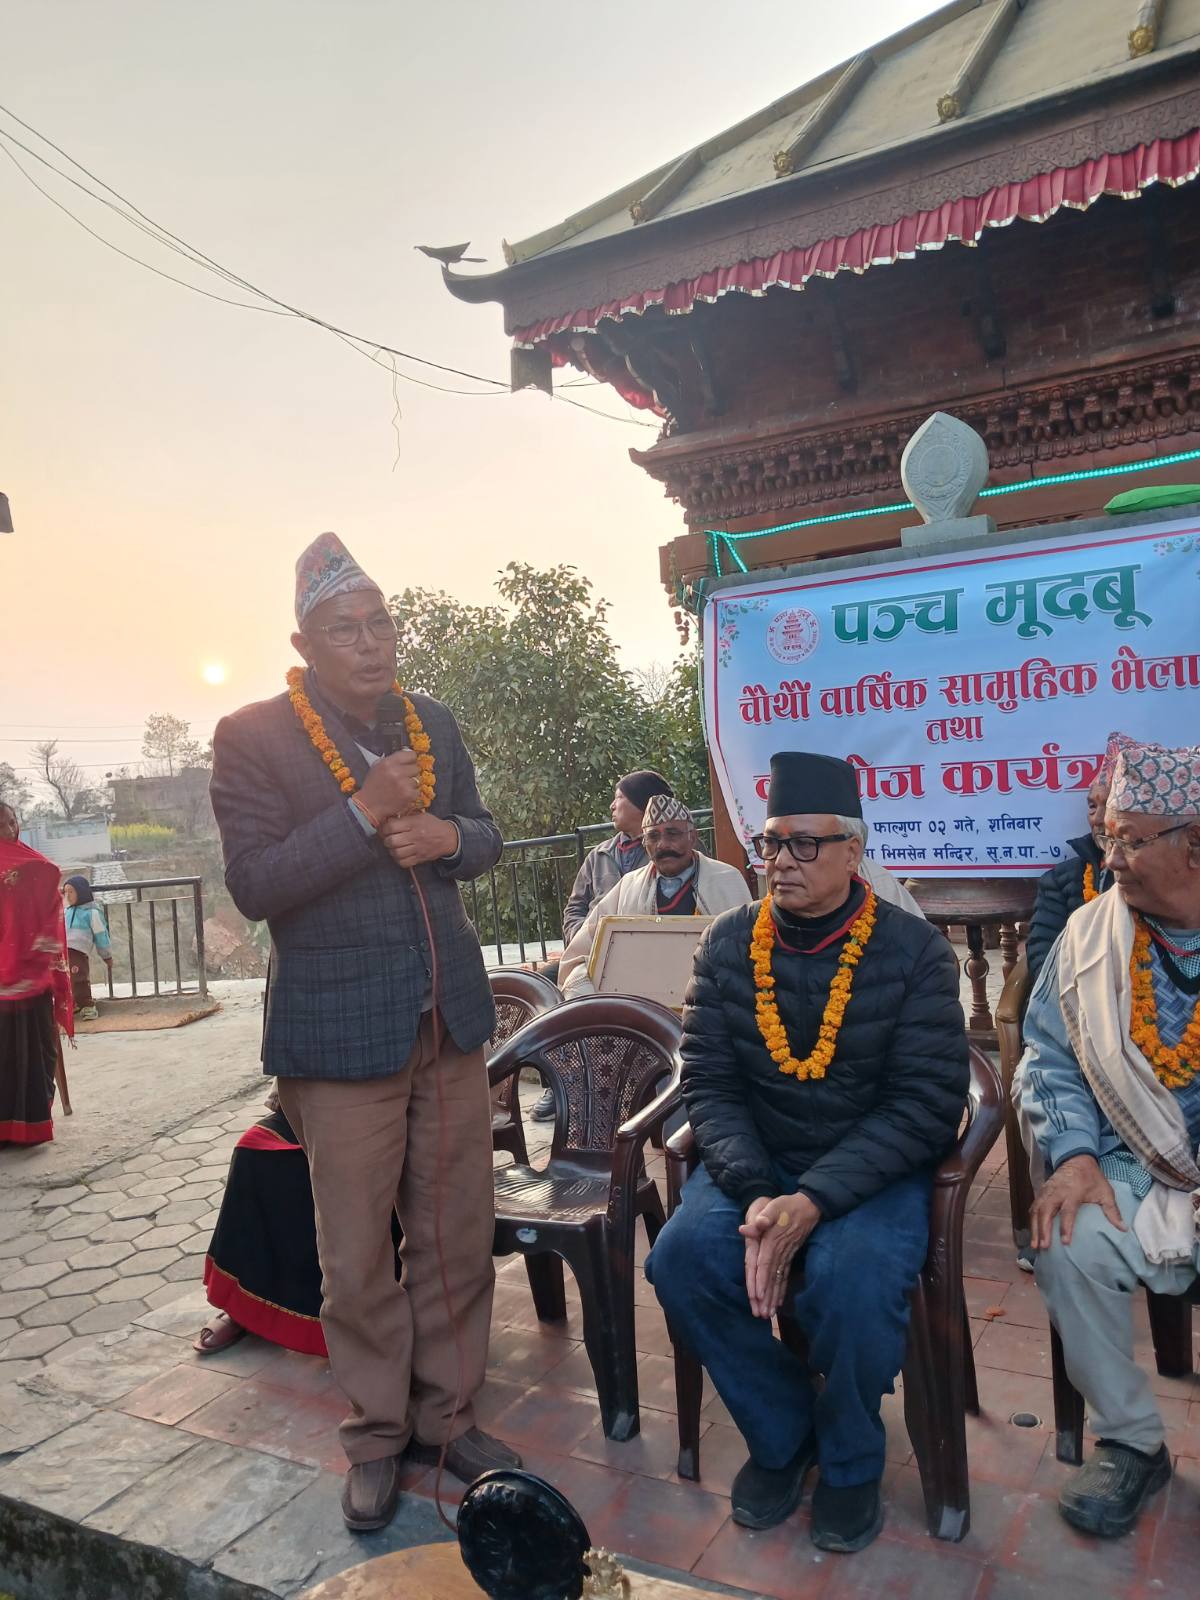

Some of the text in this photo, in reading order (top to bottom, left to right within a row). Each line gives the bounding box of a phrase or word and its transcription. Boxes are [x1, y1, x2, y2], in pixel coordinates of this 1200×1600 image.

[831, 564, 1152, 644] पञ्च मूदबू
[820, 671, 927, 716] वार्षिक
[939, 657, 1098, 712] सामुहिक
[926, 716, 984, 743] तथा
[873, 813, 1043, 837] फाल्गुण ०२ गते, शनिबार
[881, 843, 927, 862] भिमसेन
[933, 842, 979, 863] मन्दिर,
